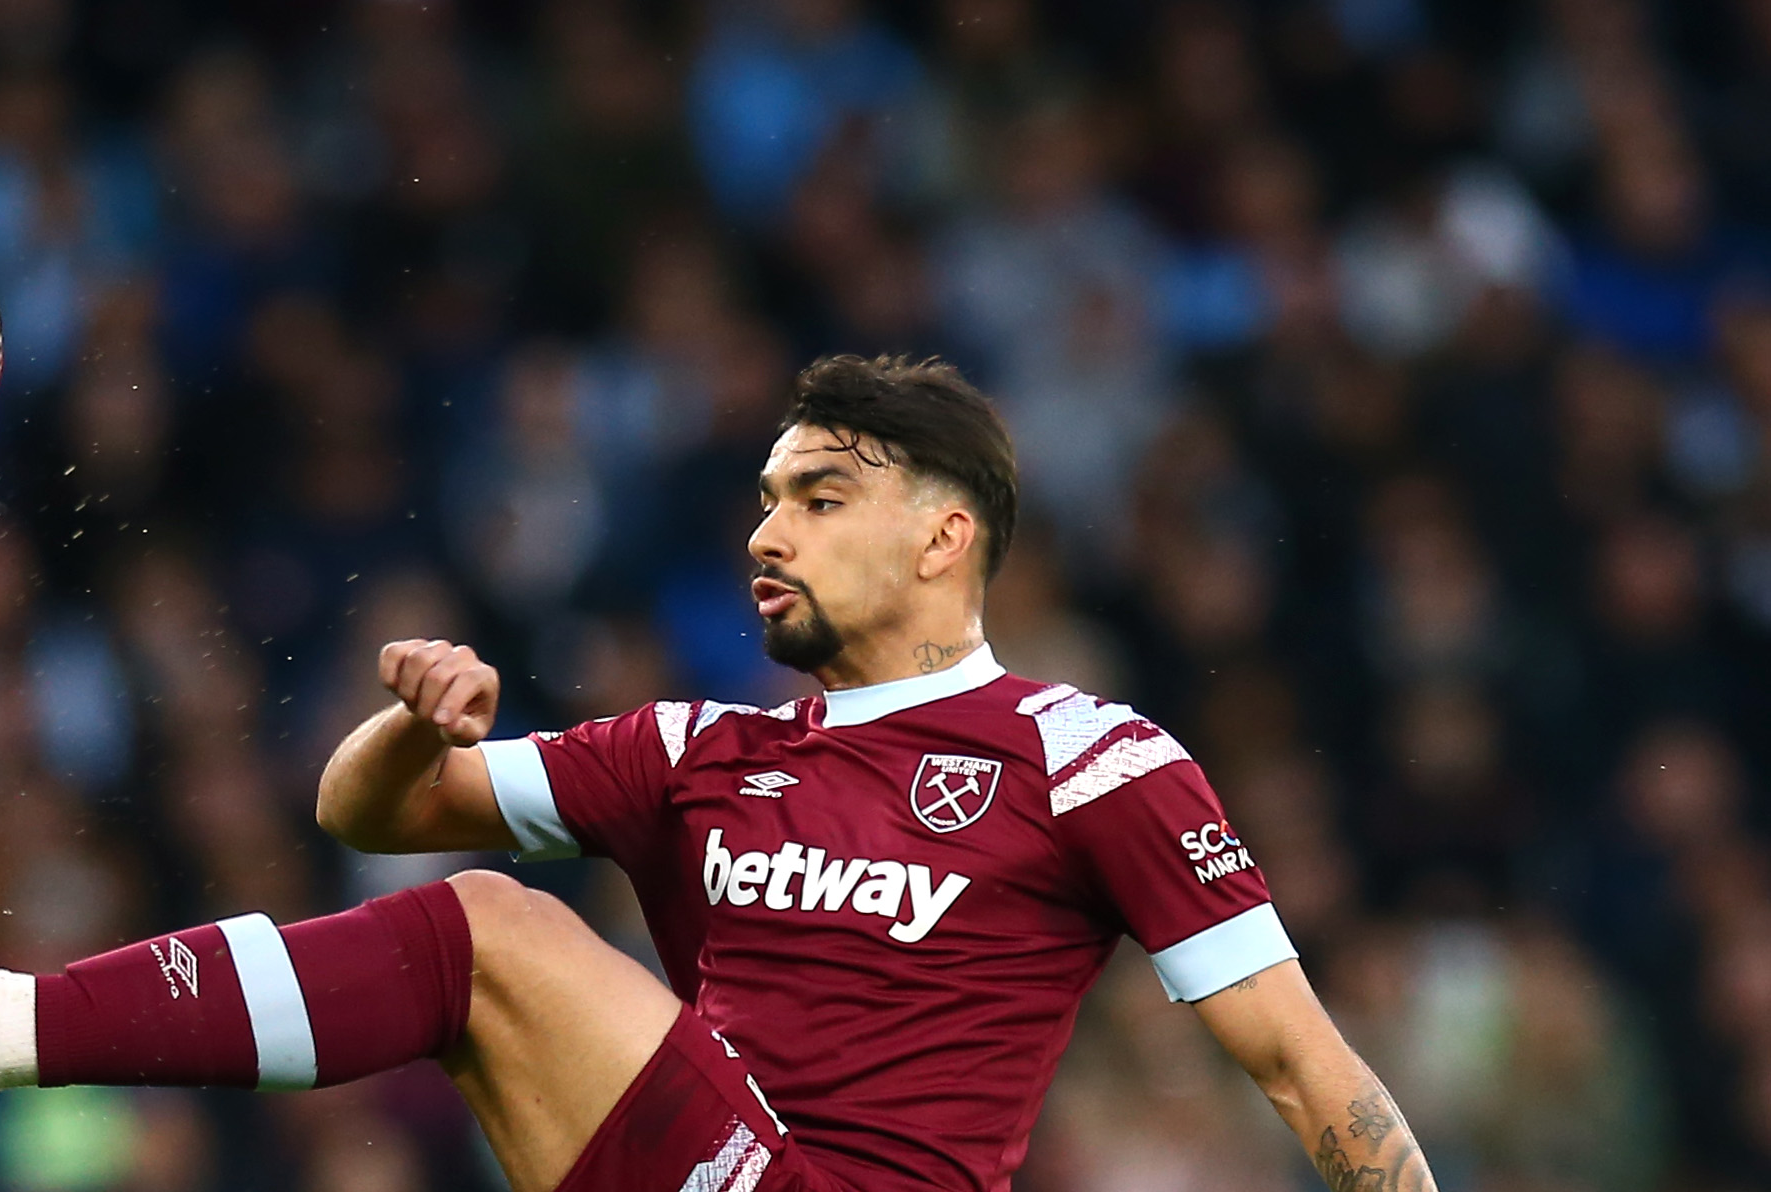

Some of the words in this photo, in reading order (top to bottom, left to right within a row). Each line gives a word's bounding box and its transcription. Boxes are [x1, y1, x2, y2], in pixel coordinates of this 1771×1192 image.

[931, 757, 962, 768] WEST
[964, 760, 991, 773] HAM
[941, 766, 977, 776] UNITED
[1194, 847, 1255, 885] MARK
[703, 828, 971, 943] betway
[150, 942, 180, 999] umbro
